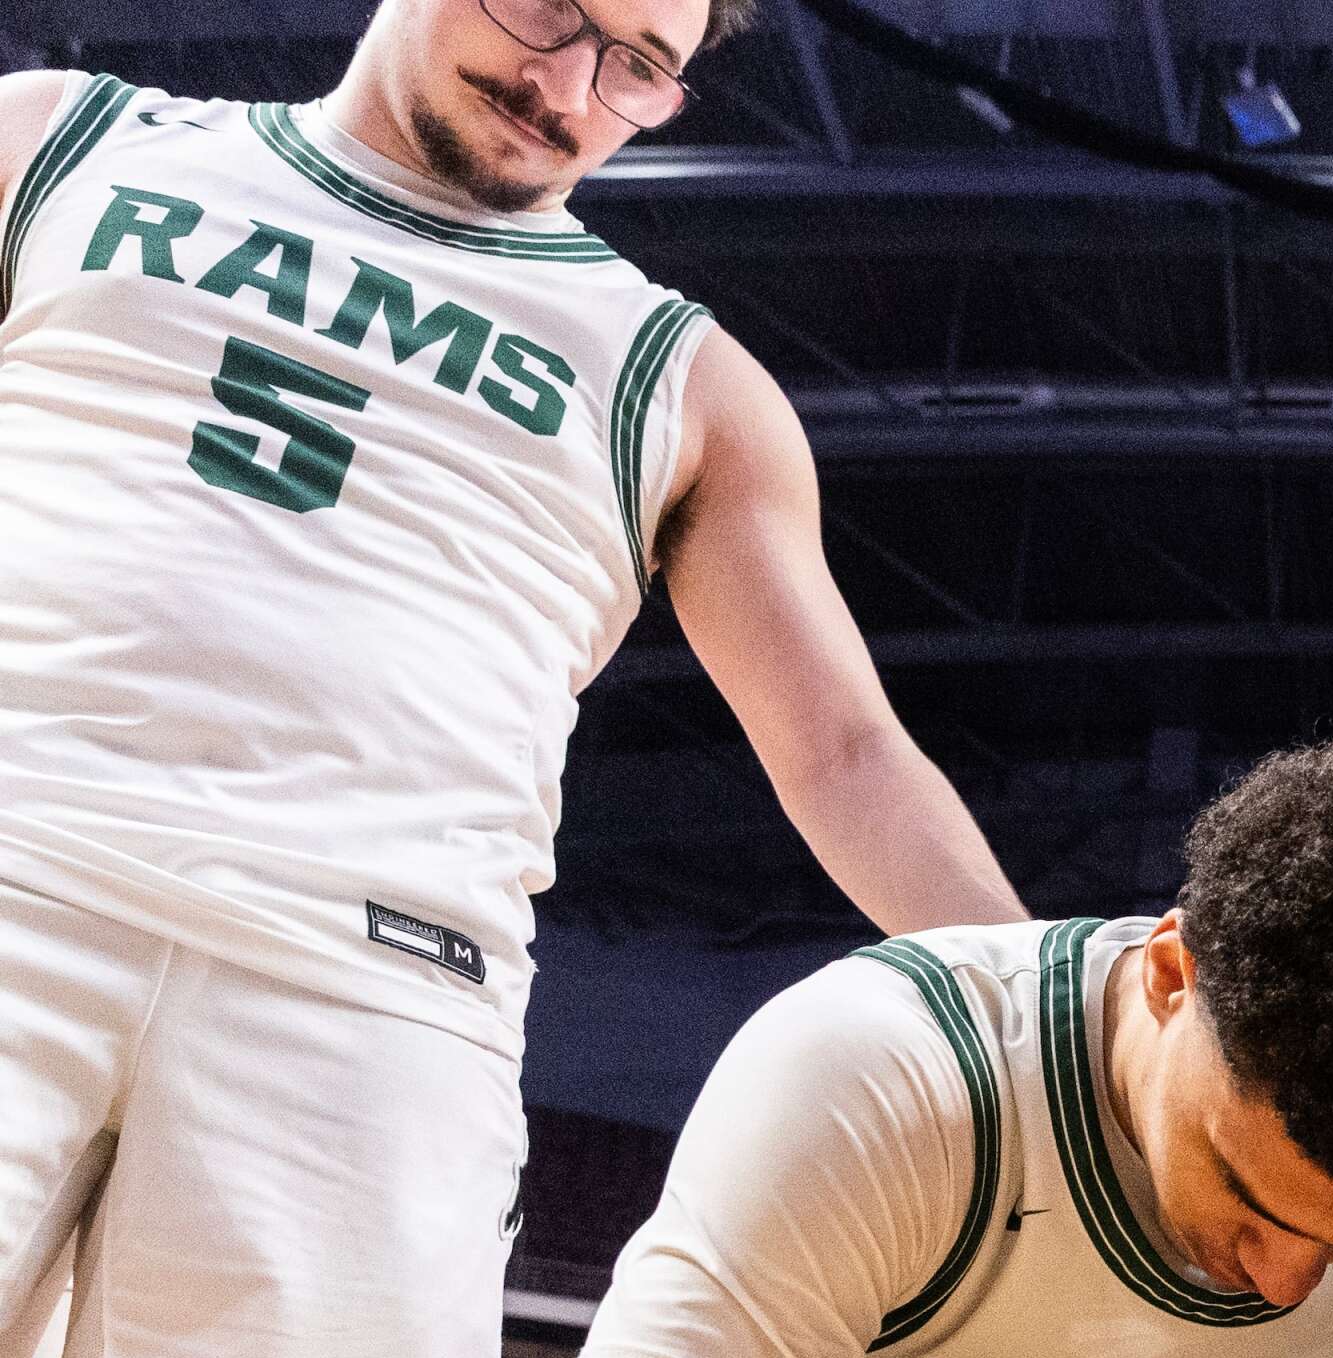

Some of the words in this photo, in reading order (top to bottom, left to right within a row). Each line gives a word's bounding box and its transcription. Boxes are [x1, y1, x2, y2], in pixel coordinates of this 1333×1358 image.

[81, 185, 575, 436] RAMS
[188, 336, 371, 514] 5
[454, 942, 472, 964] M
